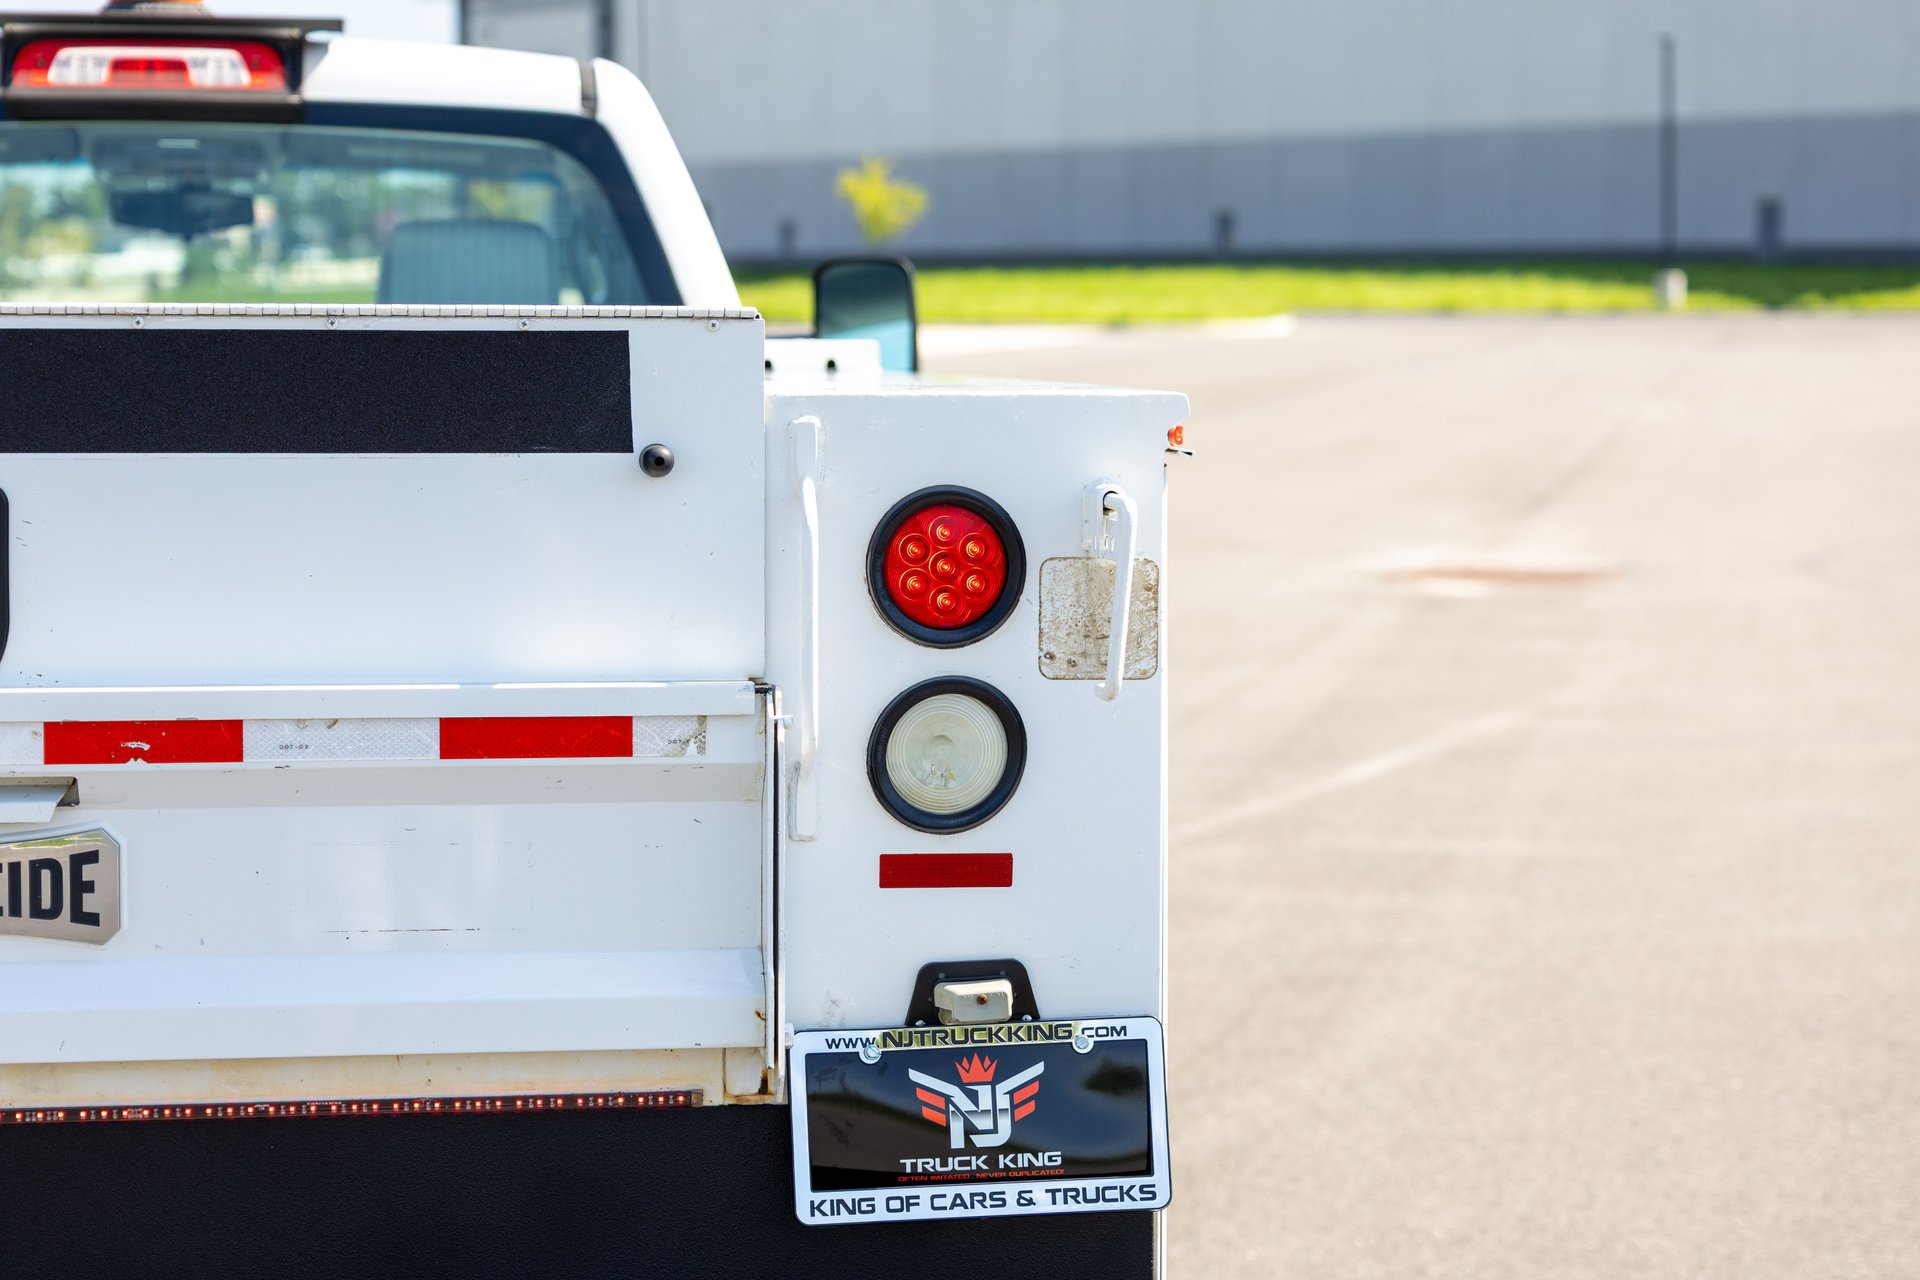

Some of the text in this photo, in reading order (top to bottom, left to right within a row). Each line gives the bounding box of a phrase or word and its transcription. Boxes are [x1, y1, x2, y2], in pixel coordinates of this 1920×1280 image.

[0, 849, 100, 927] IDE
[899, 1151, 1062, 1174] TRUCK KING
[930, 1173, 970, 1181] IMITATED
[975, 1171, 1007, 1179] NEVER
[809, 1183, 1158, 1217] KING OF CARS & TRUCKS
